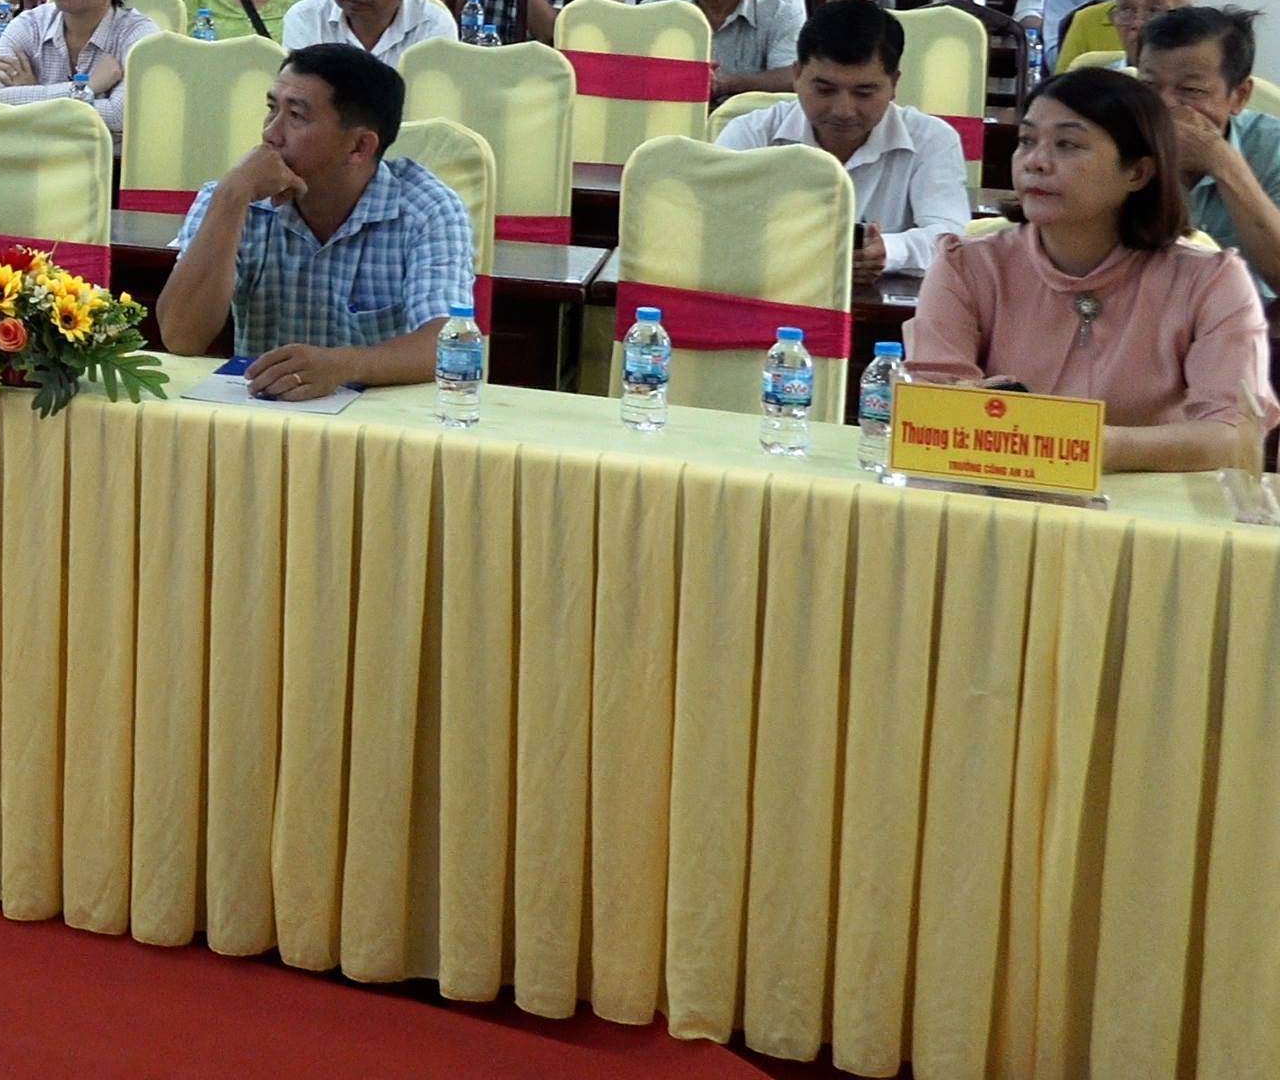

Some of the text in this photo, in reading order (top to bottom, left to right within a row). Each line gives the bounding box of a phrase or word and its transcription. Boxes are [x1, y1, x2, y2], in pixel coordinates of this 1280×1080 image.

[901, 421, 949, 451] Thượng
[973, 424, 1029, 456] NGUYỄN
[1032, 435, 1054, 464] THỊ
[1058, 438, 1091, 466] LỊCH
